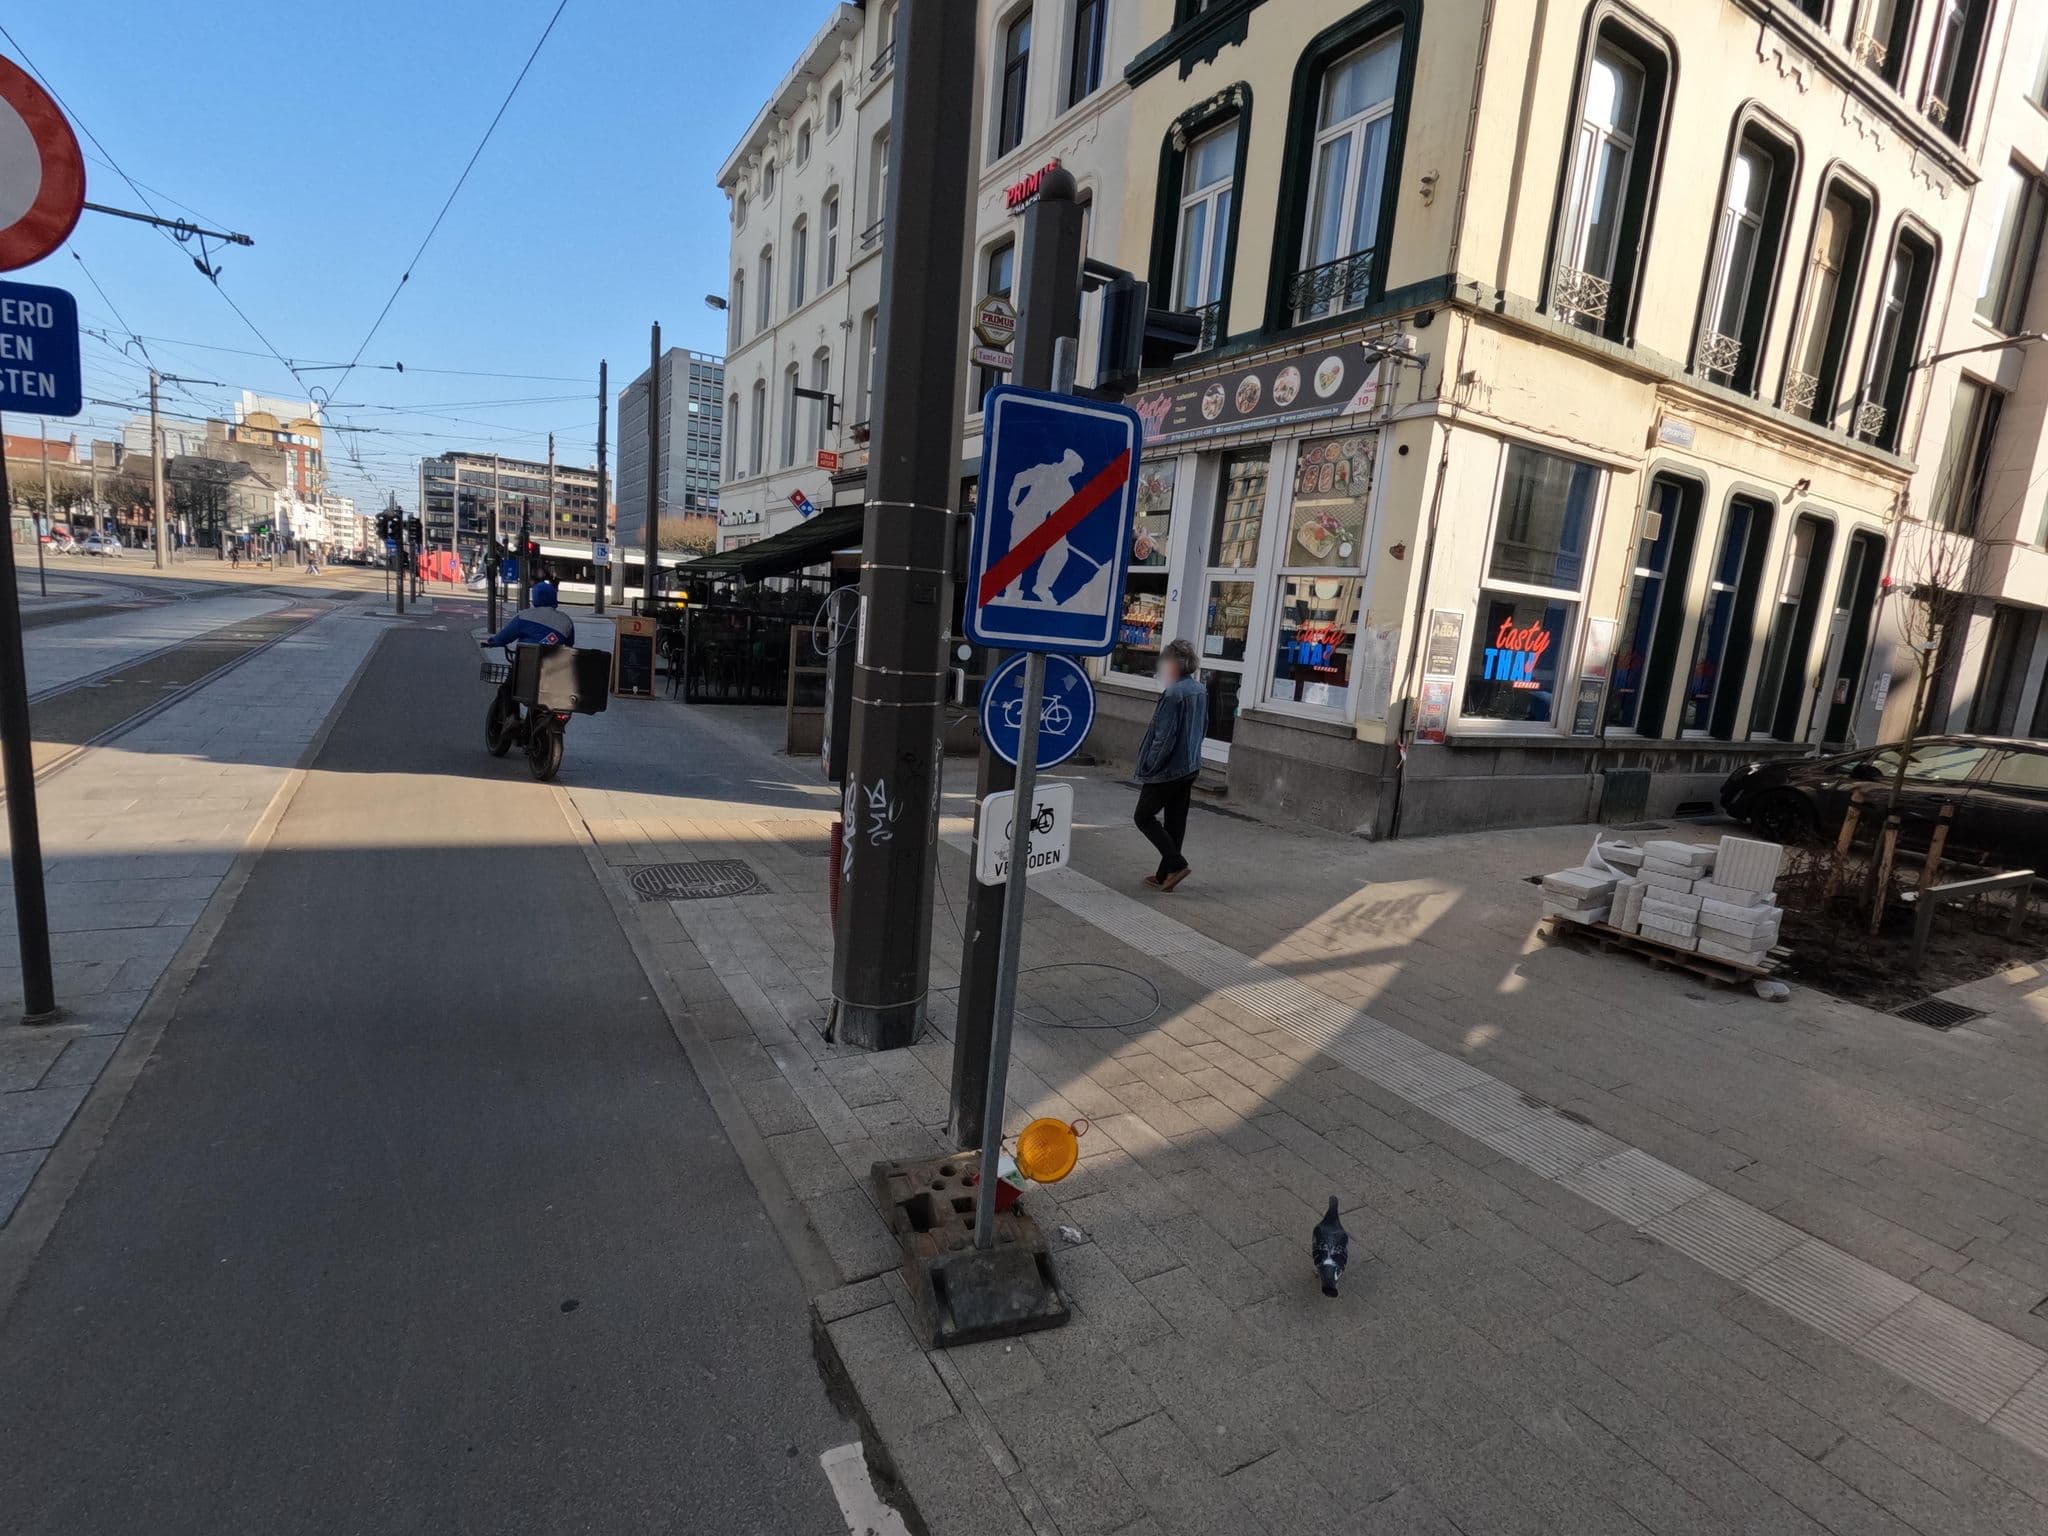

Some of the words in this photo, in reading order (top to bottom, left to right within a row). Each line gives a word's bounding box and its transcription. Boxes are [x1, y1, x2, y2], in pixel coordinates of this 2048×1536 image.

[982, 313, 1014, 328] PRIMUS
[1171, 588, 1178, 601] 2
[1296, 619, 1345, 660] tasty
[1433, 623, 1459, 638] ABBA
[1287, 640, 1332, 667] THAI
[1496, 616, 1550, 673] tasty
[1484, 648, 1537, 682] THAI
[995, 849, 1061, 877] VEODEN
